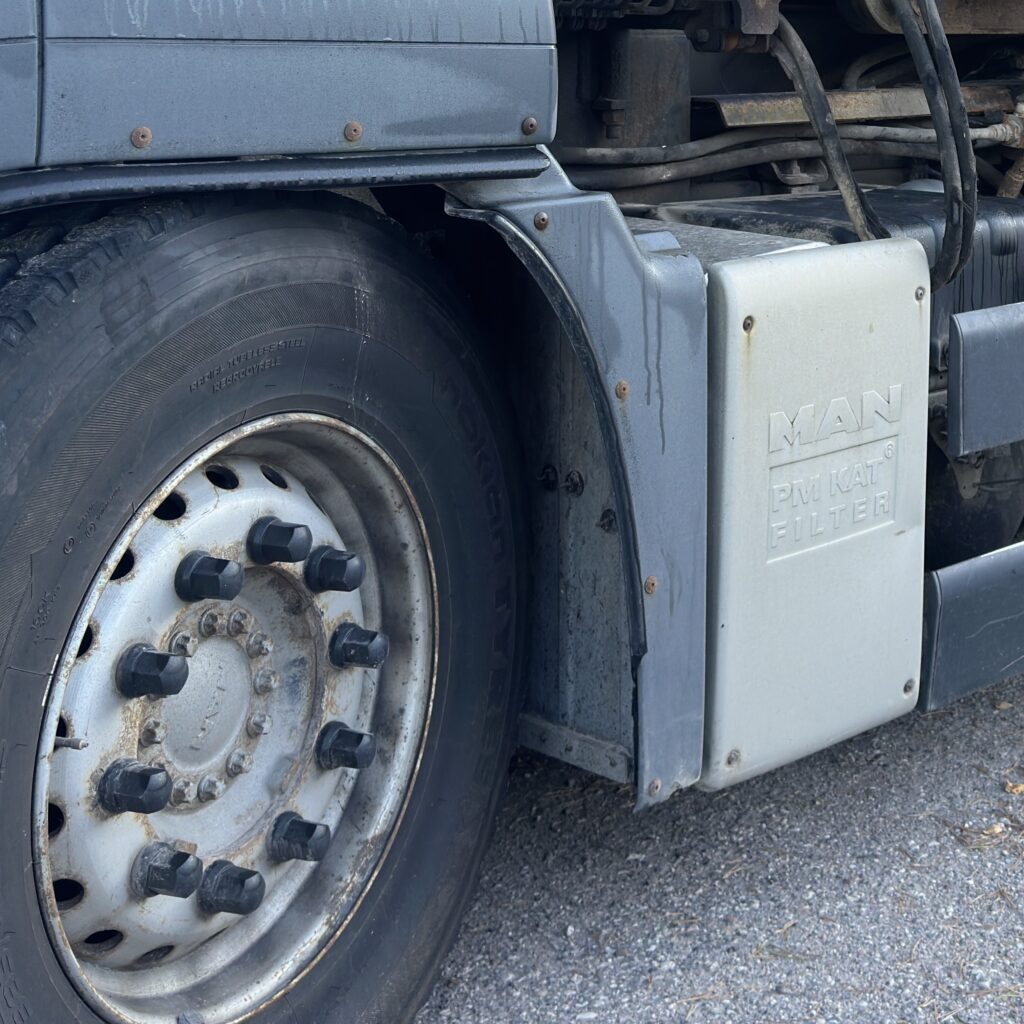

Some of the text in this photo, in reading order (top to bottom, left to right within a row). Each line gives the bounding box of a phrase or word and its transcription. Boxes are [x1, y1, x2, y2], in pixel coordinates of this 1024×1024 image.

[768, 384, 902, 453] MAN
[770, 490, 890, 549] FILTER
[771, 473, 820, 513] PM
